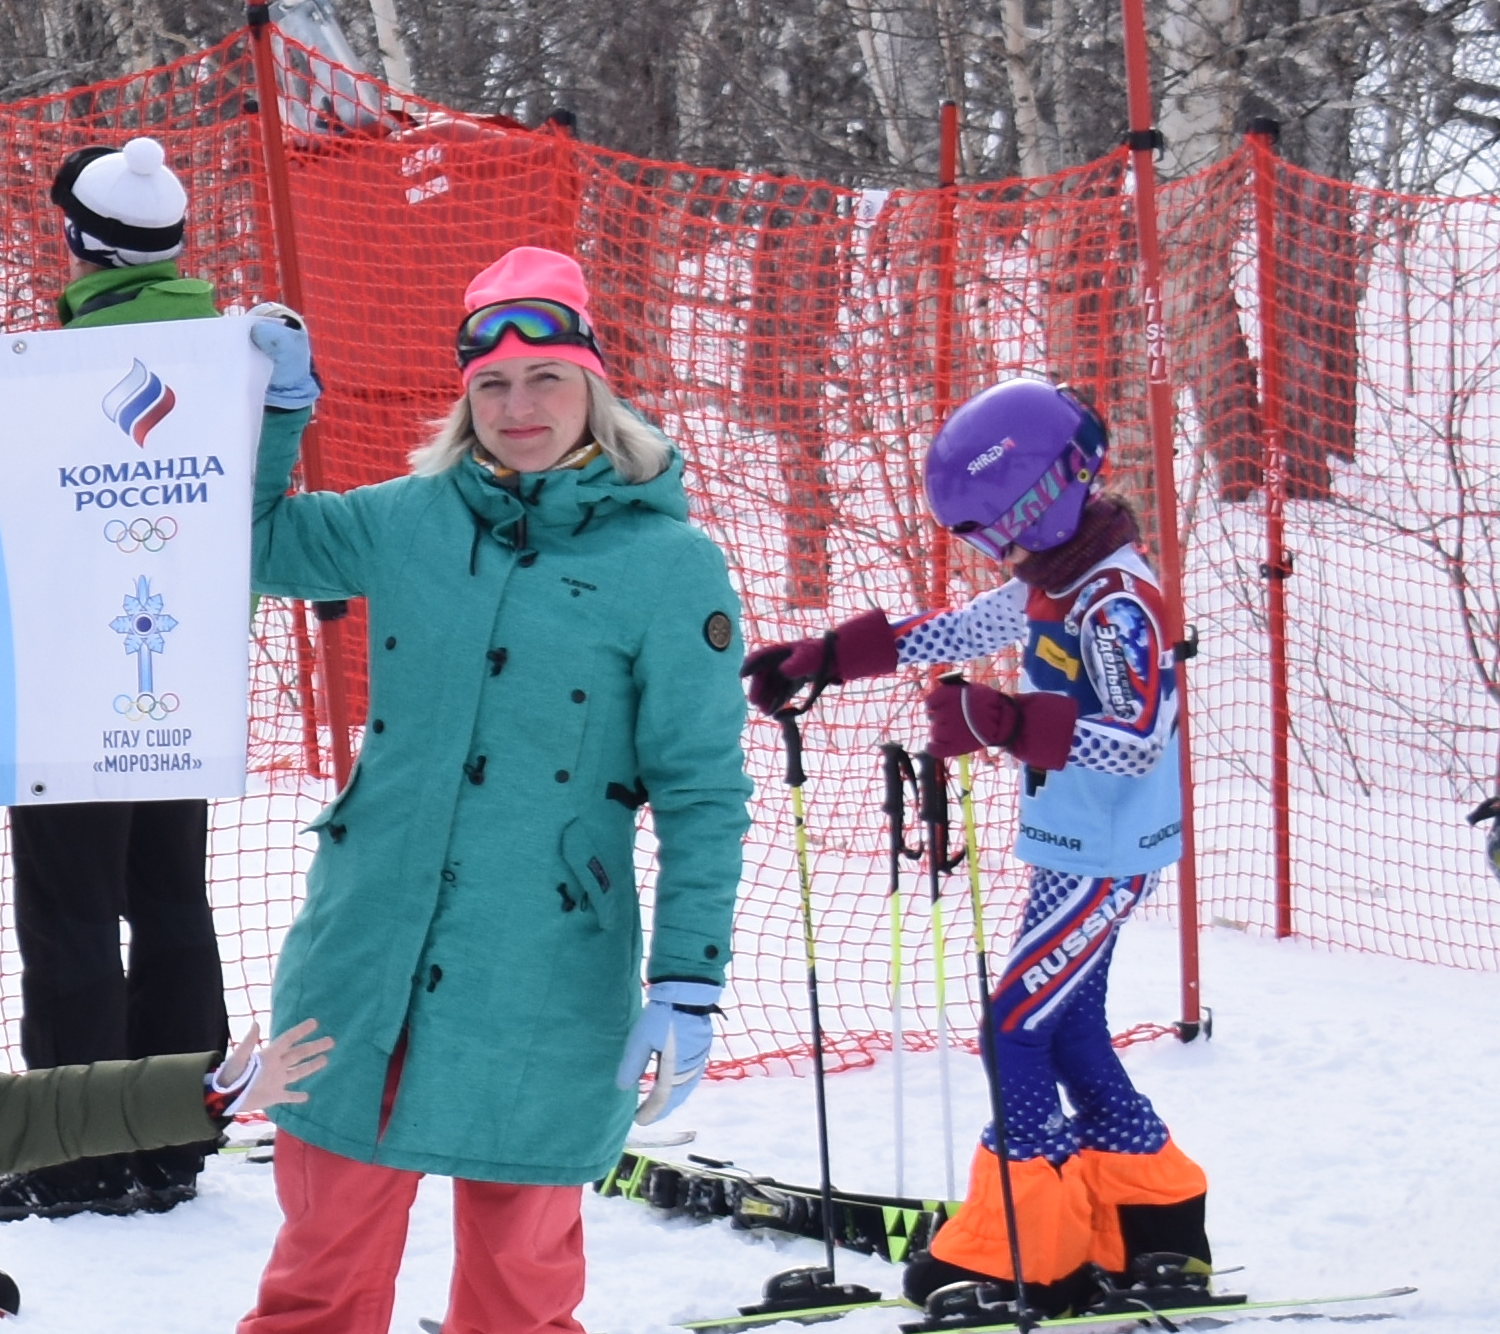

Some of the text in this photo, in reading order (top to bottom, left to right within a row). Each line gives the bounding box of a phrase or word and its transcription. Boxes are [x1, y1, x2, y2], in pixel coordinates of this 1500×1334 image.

[58, 454, 225, 488] КОМАНДА
[74, 481, 209, 512] РОССИИ
[102, 727, 193, 749] КГАУ СШОР
[92, 752, 203, 774] «МОРОЗНАЯ»
[1020, 823, 1082, 852] РОЗНАЯ
[1021, 886, 1135, 995] RUSSIA
